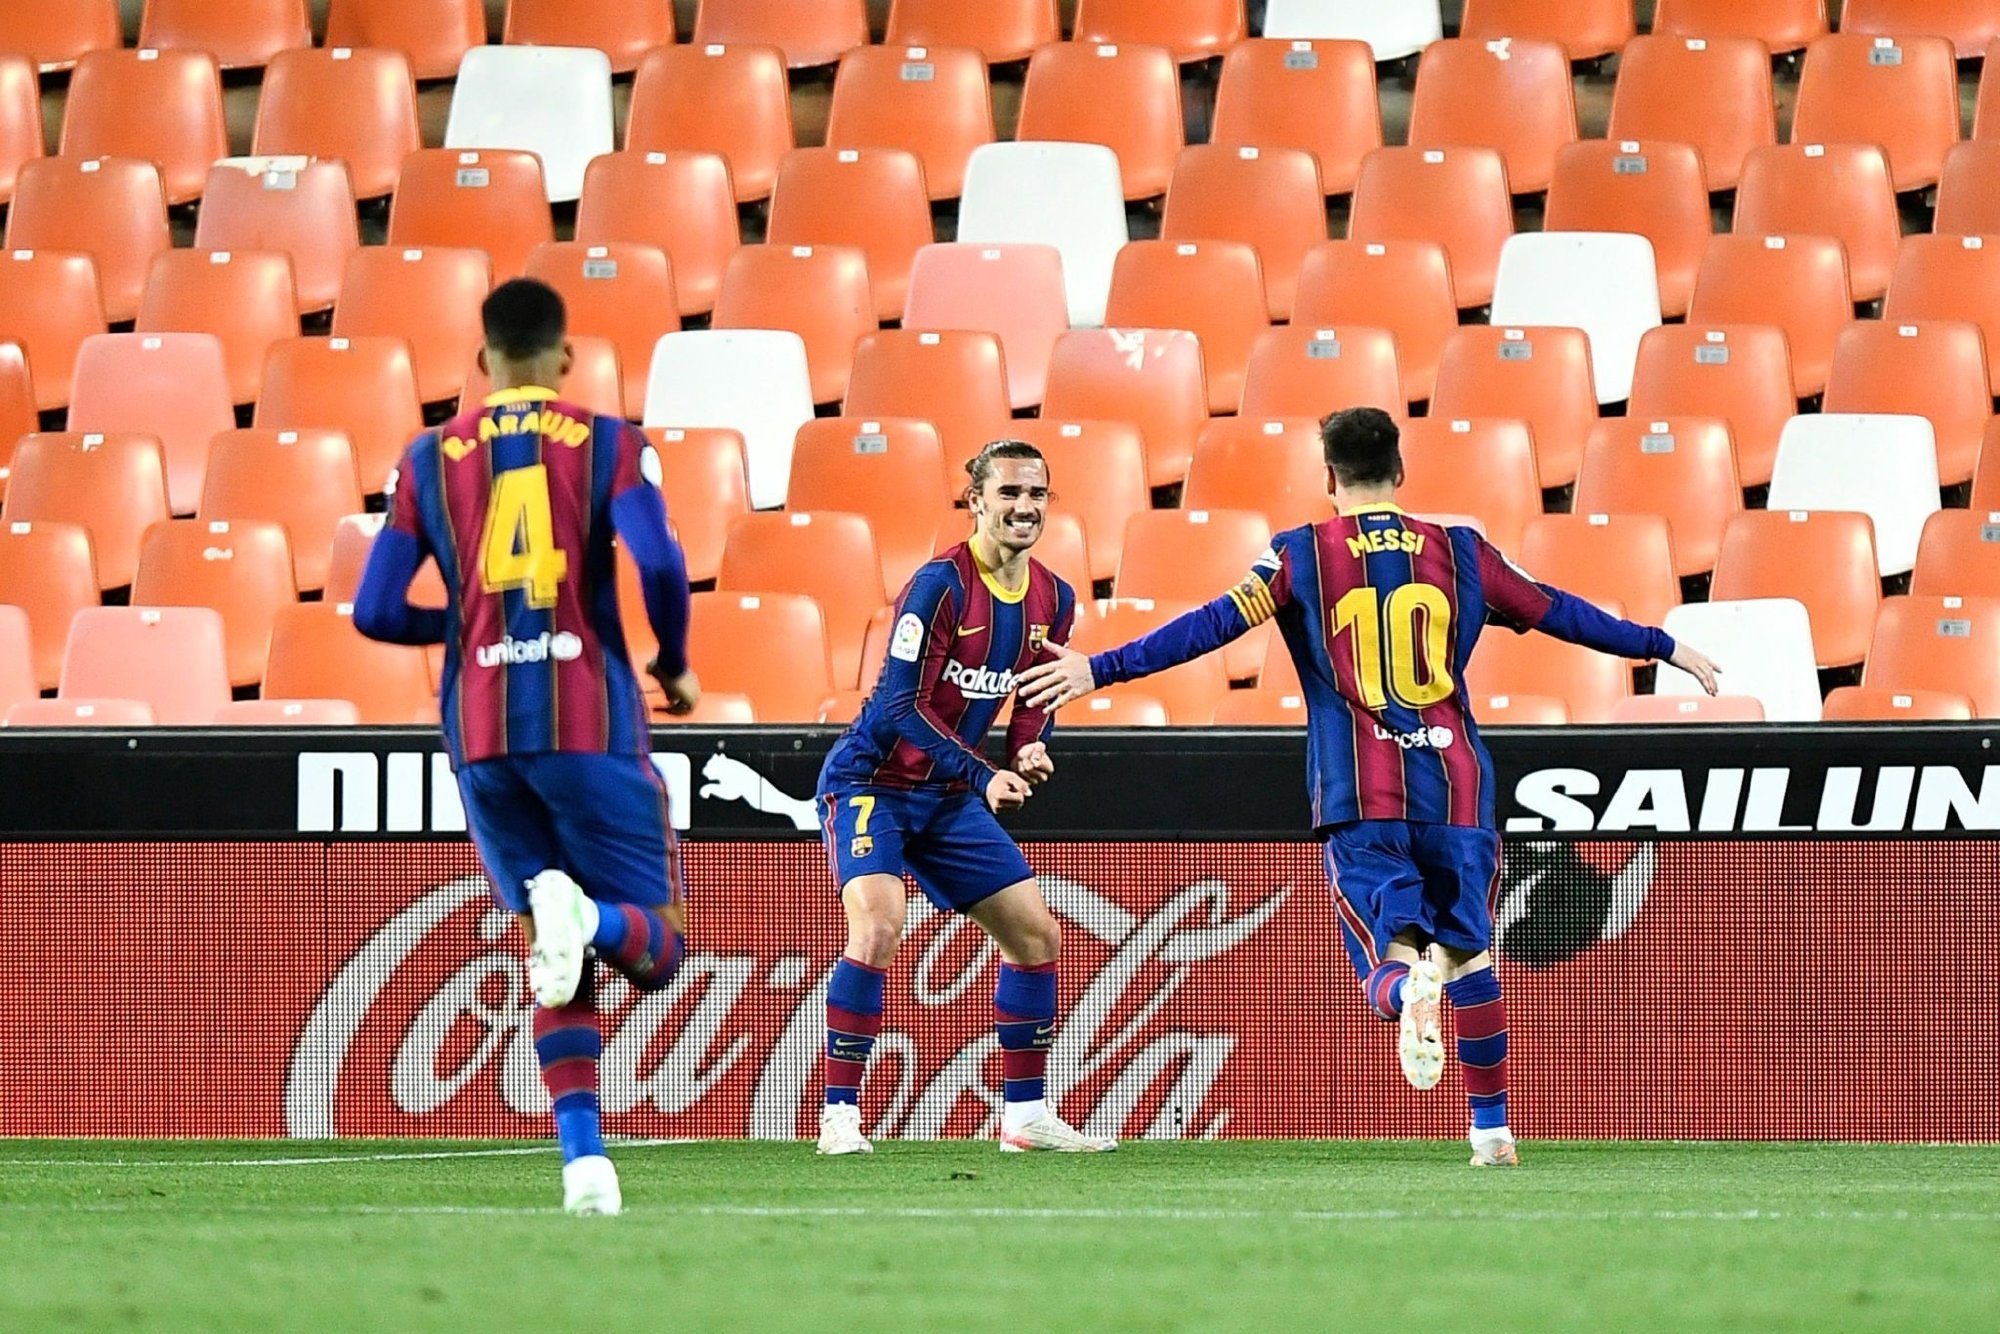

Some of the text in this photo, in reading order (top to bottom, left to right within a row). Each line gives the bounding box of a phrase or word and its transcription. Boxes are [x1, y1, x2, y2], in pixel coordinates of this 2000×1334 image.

[480, 463, 568, 610] 4
[1345, 528, 1427, 558] MESSI
[1331, 582, 1456, 711] 10
[941, 658, 1022, 696] Rakute
[849, 796, 876, 834] 7
[1506, 765, 2000, 832] SAILUN
